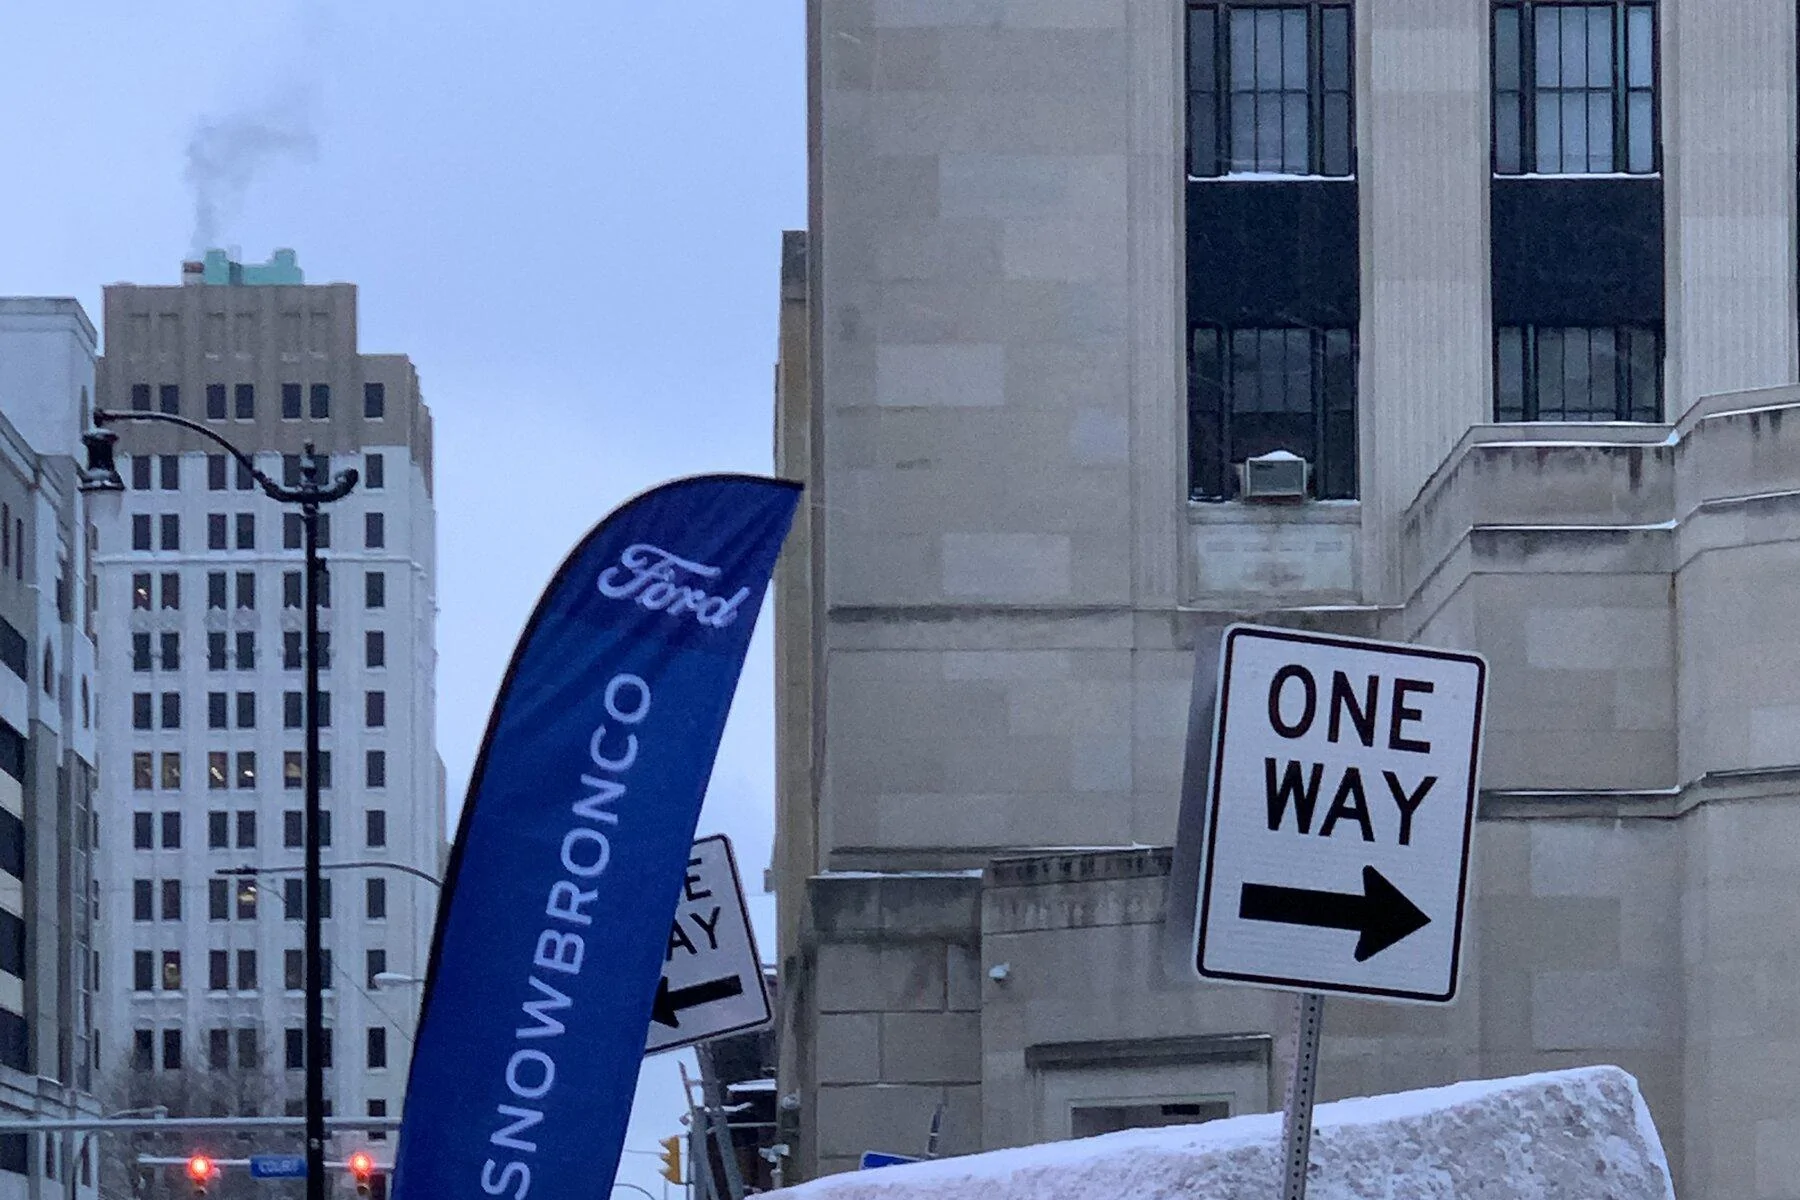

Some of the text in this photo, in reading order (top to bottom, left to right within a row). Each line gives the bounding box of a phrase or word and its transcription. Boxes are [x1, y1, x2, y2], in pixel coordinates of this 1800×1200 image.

[597, 543, 750, 629] Ford
[1268, 664, 1435, 755] ONE
[1265, 757, 1439, 847] WAY
[665, 905, 722, 962] AY
